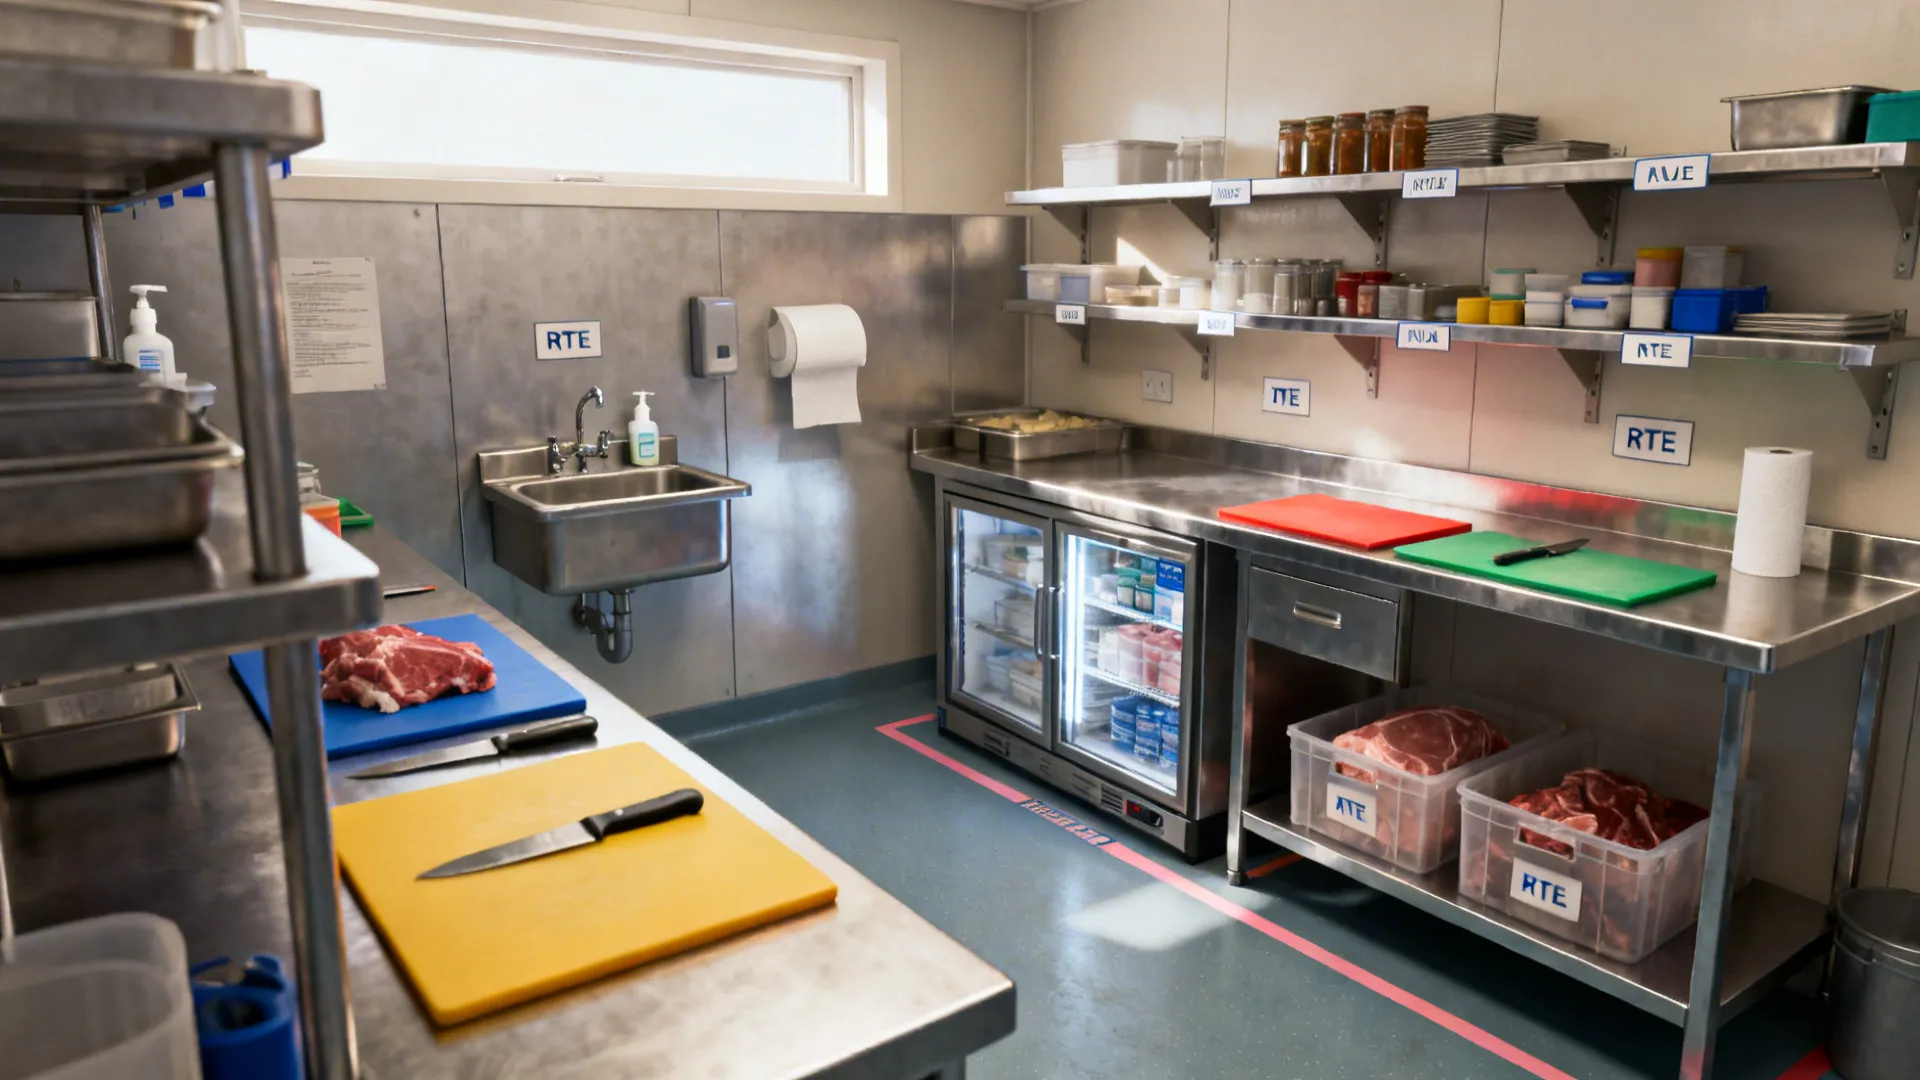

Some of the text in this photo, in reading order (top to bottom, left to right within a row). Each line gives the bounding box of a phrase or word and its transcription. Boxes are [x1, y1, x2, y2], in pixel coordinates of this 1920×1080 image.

[546, 329, 591, 351] RTE
[1627, 426, 1677, 454] RTE
[1521, 872, 1568, 909] RTE
